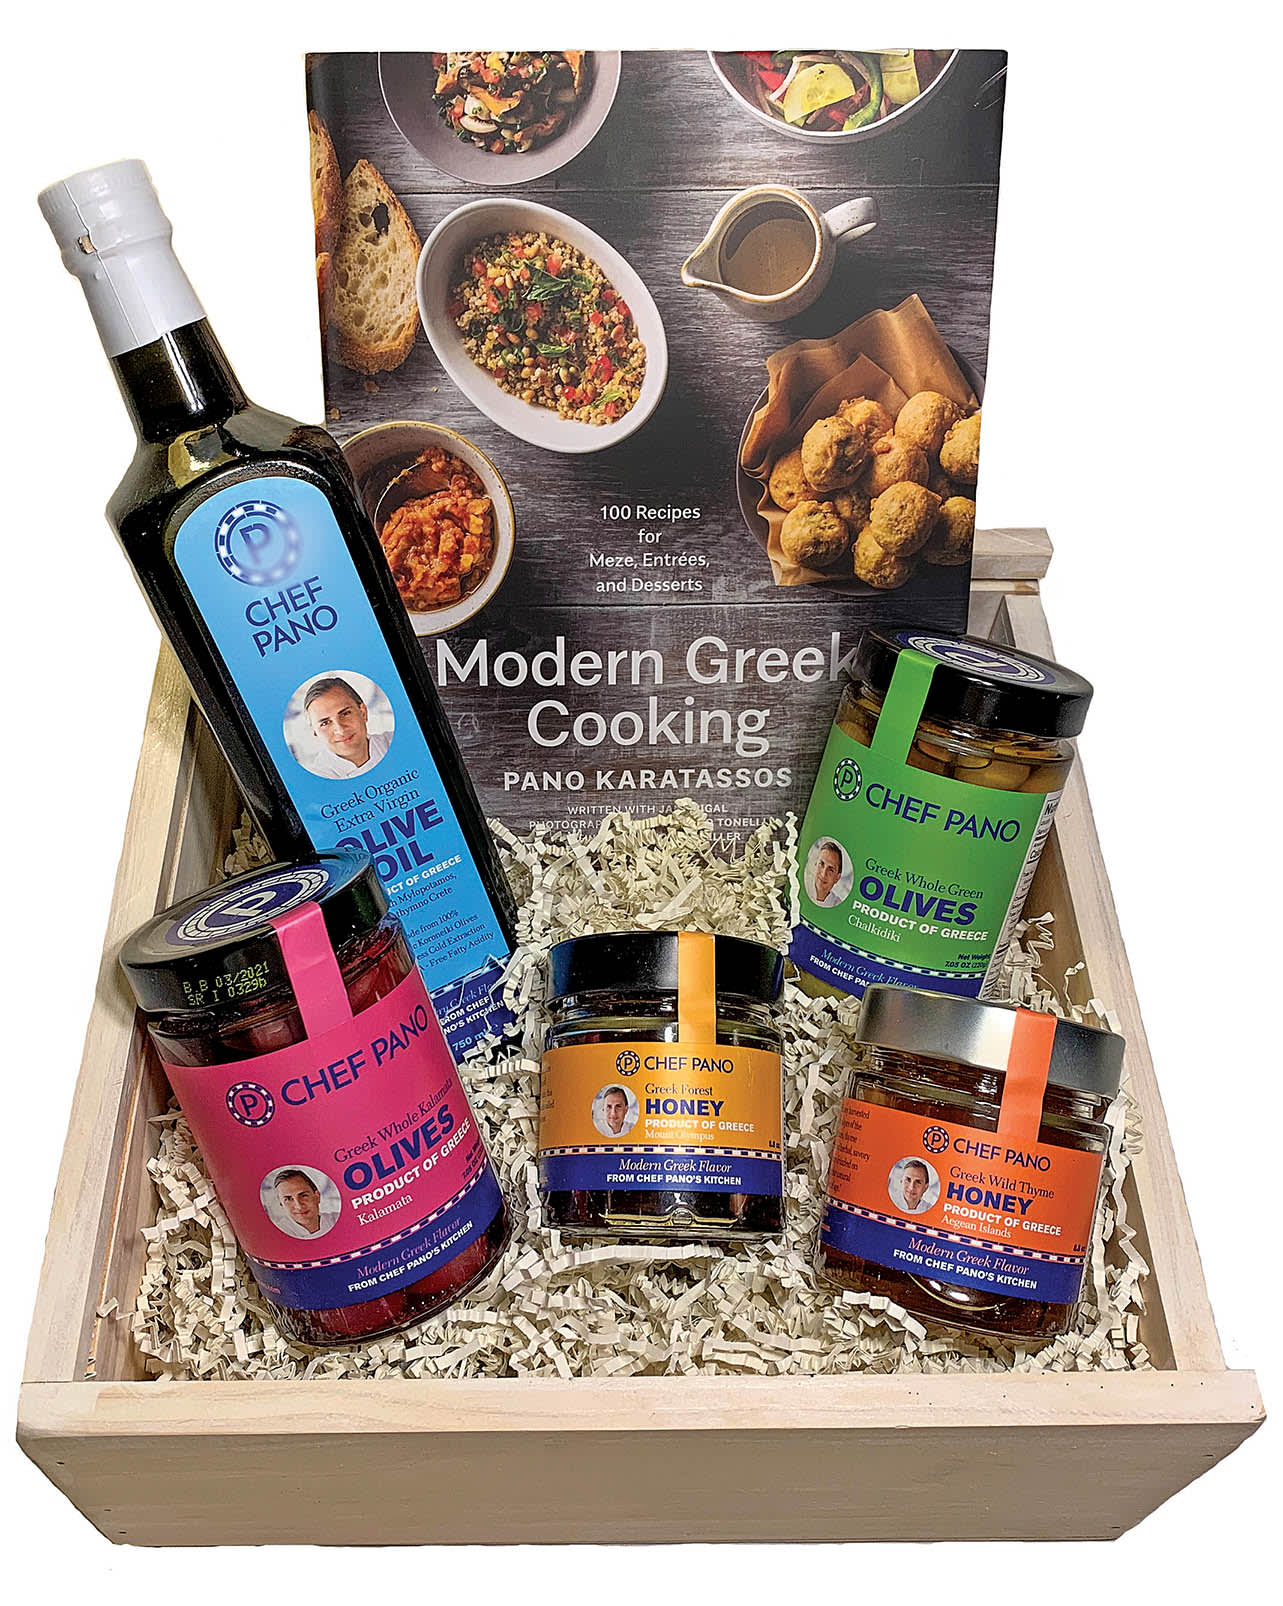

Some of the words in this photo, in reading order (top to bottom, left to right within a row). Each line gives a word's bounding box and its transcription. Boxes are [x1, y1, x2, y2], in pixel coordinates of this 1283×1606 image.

[600, 505, 632, 520] 100
[636, 505, 701, 523] Recipes
[638, 528, 662, 543] for
[589, 553, 637, 568] Meze,
[643, 550, 710, 568] Entrées,
[596, 578, 627, 593] and
[632, 577, 703, 593] Desserts
[245, 576, 323, 627] CHEF
[252, 604, 338, 659] PANO
[436, 637, 664, 687] Modern
[686, 631, 858, 684] Greek
[528, 696, 771, 757] Cooking
[320, 793, 366, 819] Greek
[364, 769, 420, 800] Organic
[503, 771, 585, 791] PANO
[596, 768, 793, 790] KARATASSOS
[335, 810, 375, 834] Extra
[373, 789, 421, 814] Virgin
[568, 805, 621, 815] WRITTEN
[624, 805, 656, 814] WITH
[865, 783, 941, 825] CHEF
[943, 808, 1021, 843] PANO
[375, 840, 435, 882] OIL
[405, 874, 421, 886] OF
[421, 855, 463, 879] GREECE
[428, 886, 454, 903] Crete
[865, 858, 904, 881] Greek
[903, 870, 946, 894] Whole
[946, 882, 984, 901] Green
[859, 876, 978, 926] OLIVES
[419, 919, 439, 933] from
[438, 909, 460, 924] 100%
[453, 913, 480, 929] Olives
[847, 914, 901, 943] Chalkidiki
[852, 900, 918, 932] PRODUCT
[919, 919, 939, 936] OF
[940, 927, 989, 942] GREECE
[428, 940, 448, 955] Cold
[447, 923, 486, 948] Extraction
[215, 960, 270, 988] 03/2021
[429, 954, 449, 968] Free
[809, 954, 832, 972] FROM
[831, 966, 855, 982] CHEF
[820, 949, 855, 974] Modern
[855, 965, 885, 984] Greek
[187, 993, 205, 1006] SR
[465, 996, 491, 1012] CHEF
[452, 1036, 473, 1051] 750
[240, 1094, 258, 1117] P
[280, 1052, 366, 1107] CHEF
[375, 1004, 429, 1067] PANO
[644, 1056, 687, 1071] CHEF
[692, 1058, 734, 1074] PANO
[645, 1083, 679, 1097] Greek
[681, 1083, 714, 1096] Forest
[645, 1098, 725, 1117] HONEY
[333, 1135, 379, 1165] Greek
[377, 1111, 420, 1144] Whole
[644, 1129, 674, 1140] Mount
[645, 1118, 699, 1130] PRODUCT
[701, 1119, 717, 1130] OF
[717, 1121, 755, 1133] GREECE
[343, 1104, 455, 1191] OLIVES
[351, 1169, 422, 1210] PRODUCT
[422, 1155, 440, 1174] OF
[439, 1117, 472, 1160] GREECE
[953, 1137, 1001, 1160] CHEF
[1005, 1150, 1051, 1172] PANO
[606, 1173, 635, 1183] FROM
[636, 1173, 664, 1183] CHEF
[665, 1173, 702, 1184] PANO'S
[703, 1174, 742, 1186] KITCHEN
[619, 1158, 662, 1172] Modern
[663, 1159, 697, 1173] Greek
[697, 1159, 733, 1173] Flavor
[949, 1166, 985, 1185] Greek
[988, 1173, 1018, 1193] Wild
[1018, 1182, 1055, 1199] Thyme
[358, 1193, 413, 1226] Kalamata
[946, 1183, 1034, 1215] HONEY
[941, 1215, 977, 1233] Aegean
[978, 1222, 1012, 1239] Islands
[943, 1203, 1002, 1226] PRODUCT
[1003, 1215, 1021, 1228] OF
[1021, 1219, 1062, 1237] GREECE
[348, 1275, 376, 1293] FROM
[376, 1262, 405, 1284] CHEF
[406, 1242, 440, 1273] PANO'S
[439, 1220, 473, 1253] KITCHEN
[356, 1252, 400, 1280] Modern
[400, 1236, 432, 1264] Greek
[430, 1217, 462, 1246] Flavor
[908, 1236, 954, 1259] Modern
[955, 1249, 991, 1268] Greek
[991, 1258, 1030, 1276] Flavor
[893, 1248, 924, 1265] FROM
[924, 1257, 955, 1273] CHEF
[954, 1264, 995, 1282] PANO'S
[996, 1274, 1038, 1290] KITCHEN
